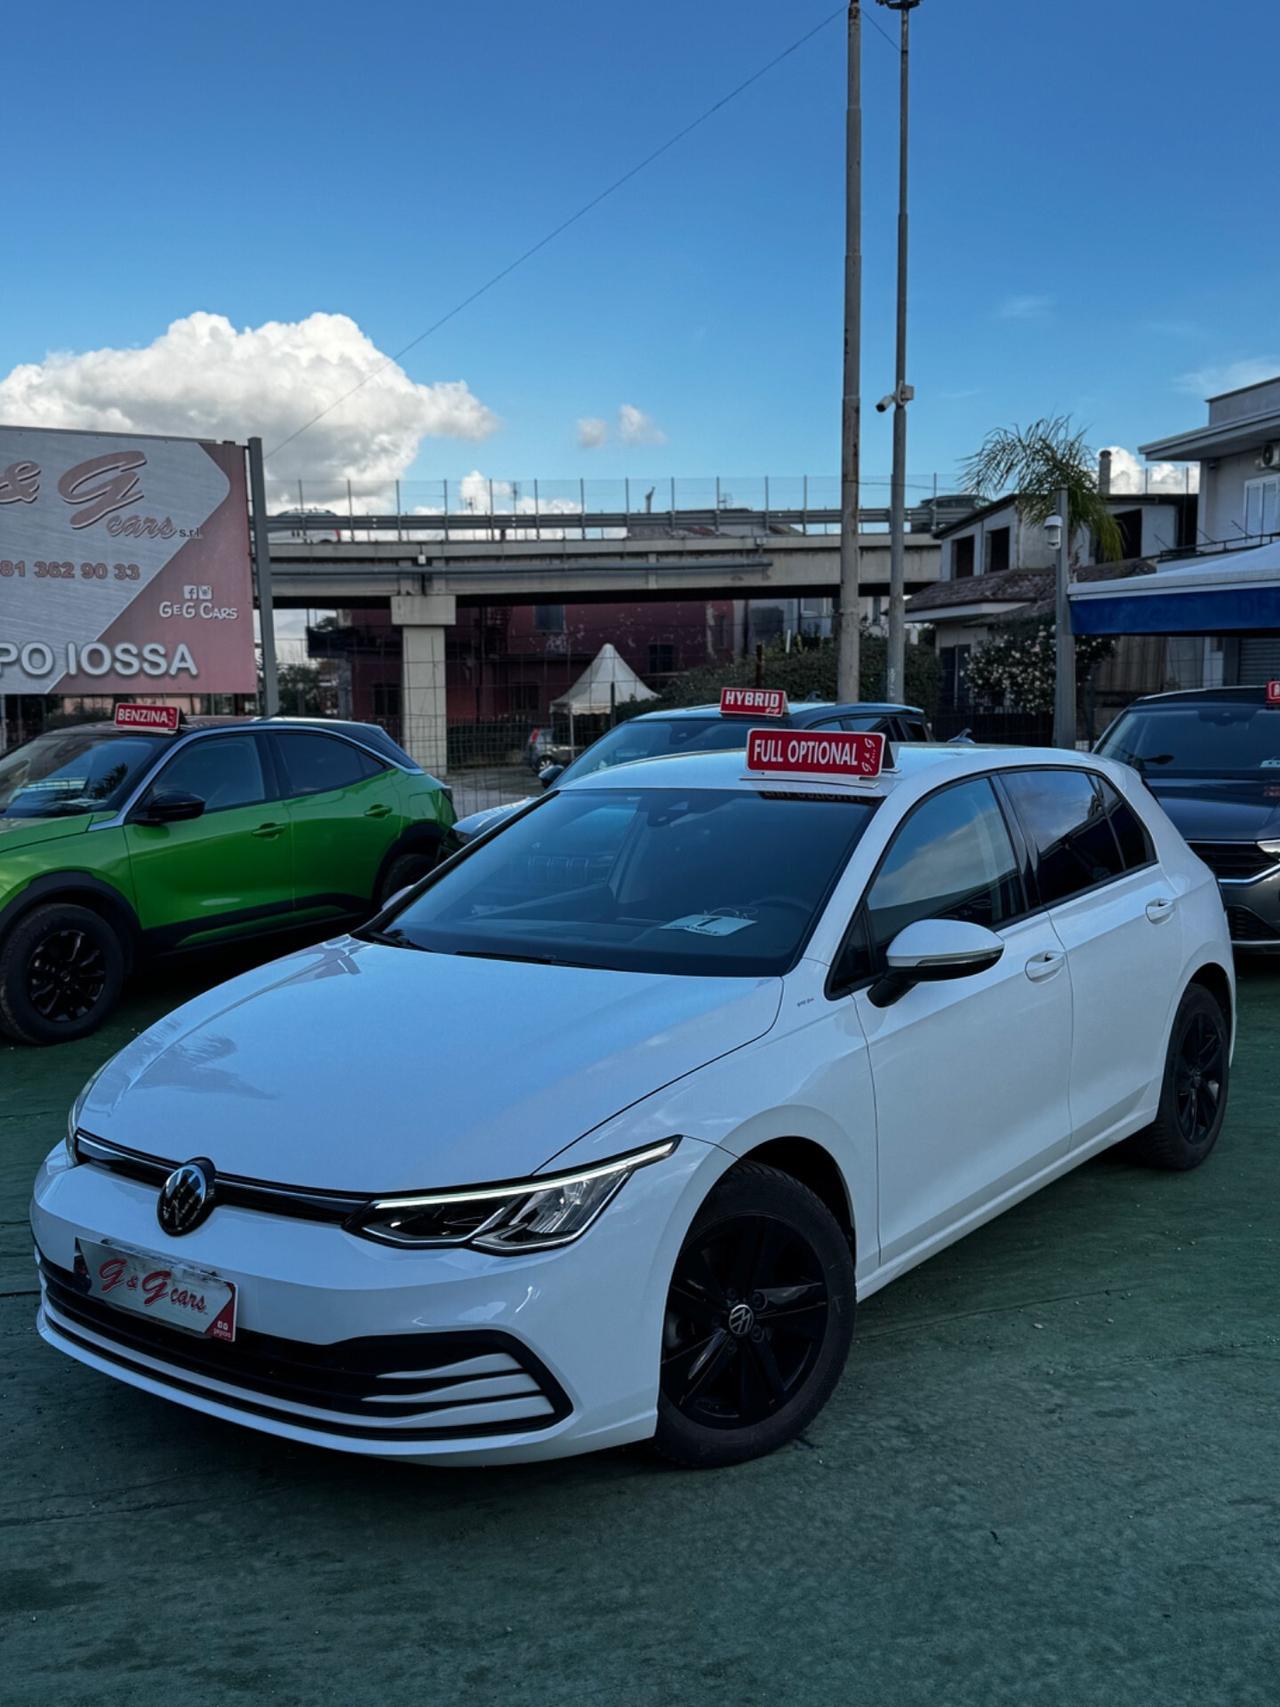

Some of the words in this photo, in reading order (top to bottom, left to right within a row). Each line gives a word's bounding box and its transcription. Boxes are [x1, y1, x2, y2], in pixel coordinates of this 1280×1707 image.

[80, 562, 108, 580] 90
[113, 563, 141, 580] 33
[66, 642, 199, 677] IOSSA
[725, 690, 780, 707] HYBRID
[117, 708, 169, 724] BENZINA
[753, 739, 784, 763] FULL
[787, 740, 858, 766] OPTIONAL
